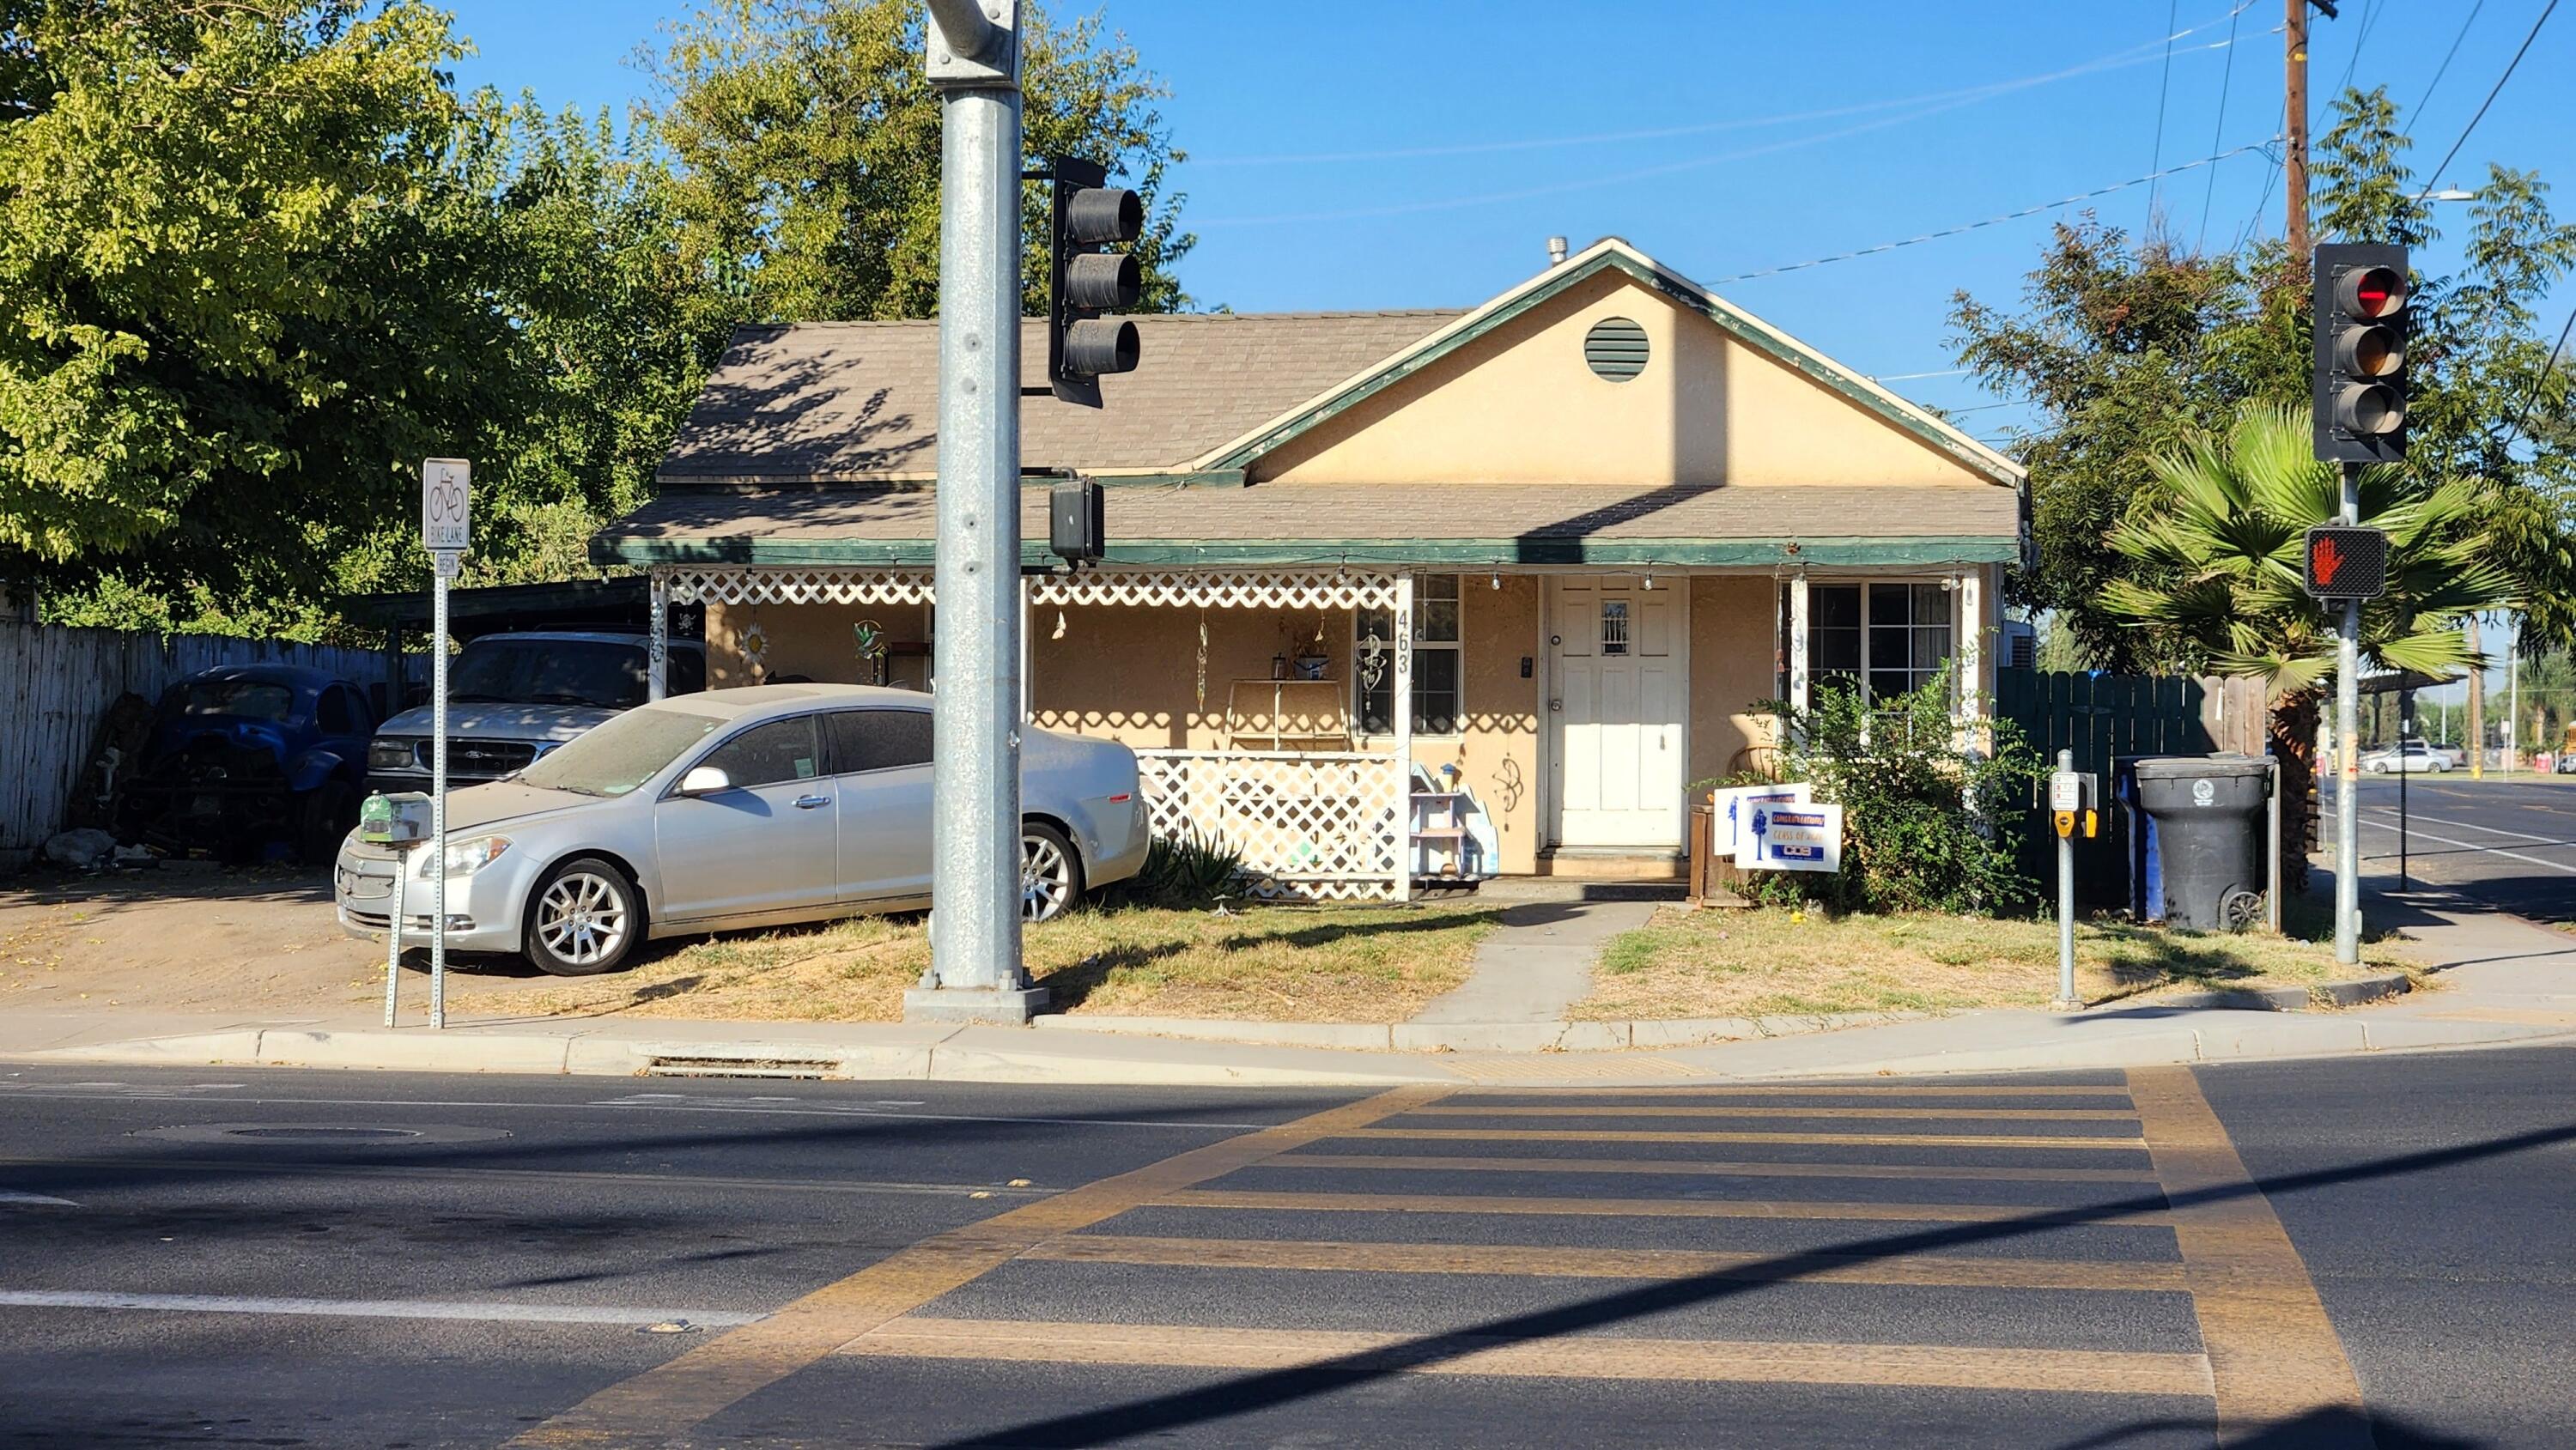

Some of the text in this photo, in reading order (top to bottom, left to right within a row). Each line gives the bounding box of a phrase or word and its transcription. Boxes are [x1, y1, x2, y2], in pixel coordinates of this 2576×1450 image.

[431, 526, 463, 543] BIKE LANE
[439, 557, 455, 572] BEGIN
[1399, 610, 1408, 673] 463
[1773, 830, 1793, 840] CLASS
[1795, 831, 1805, 841] OF
